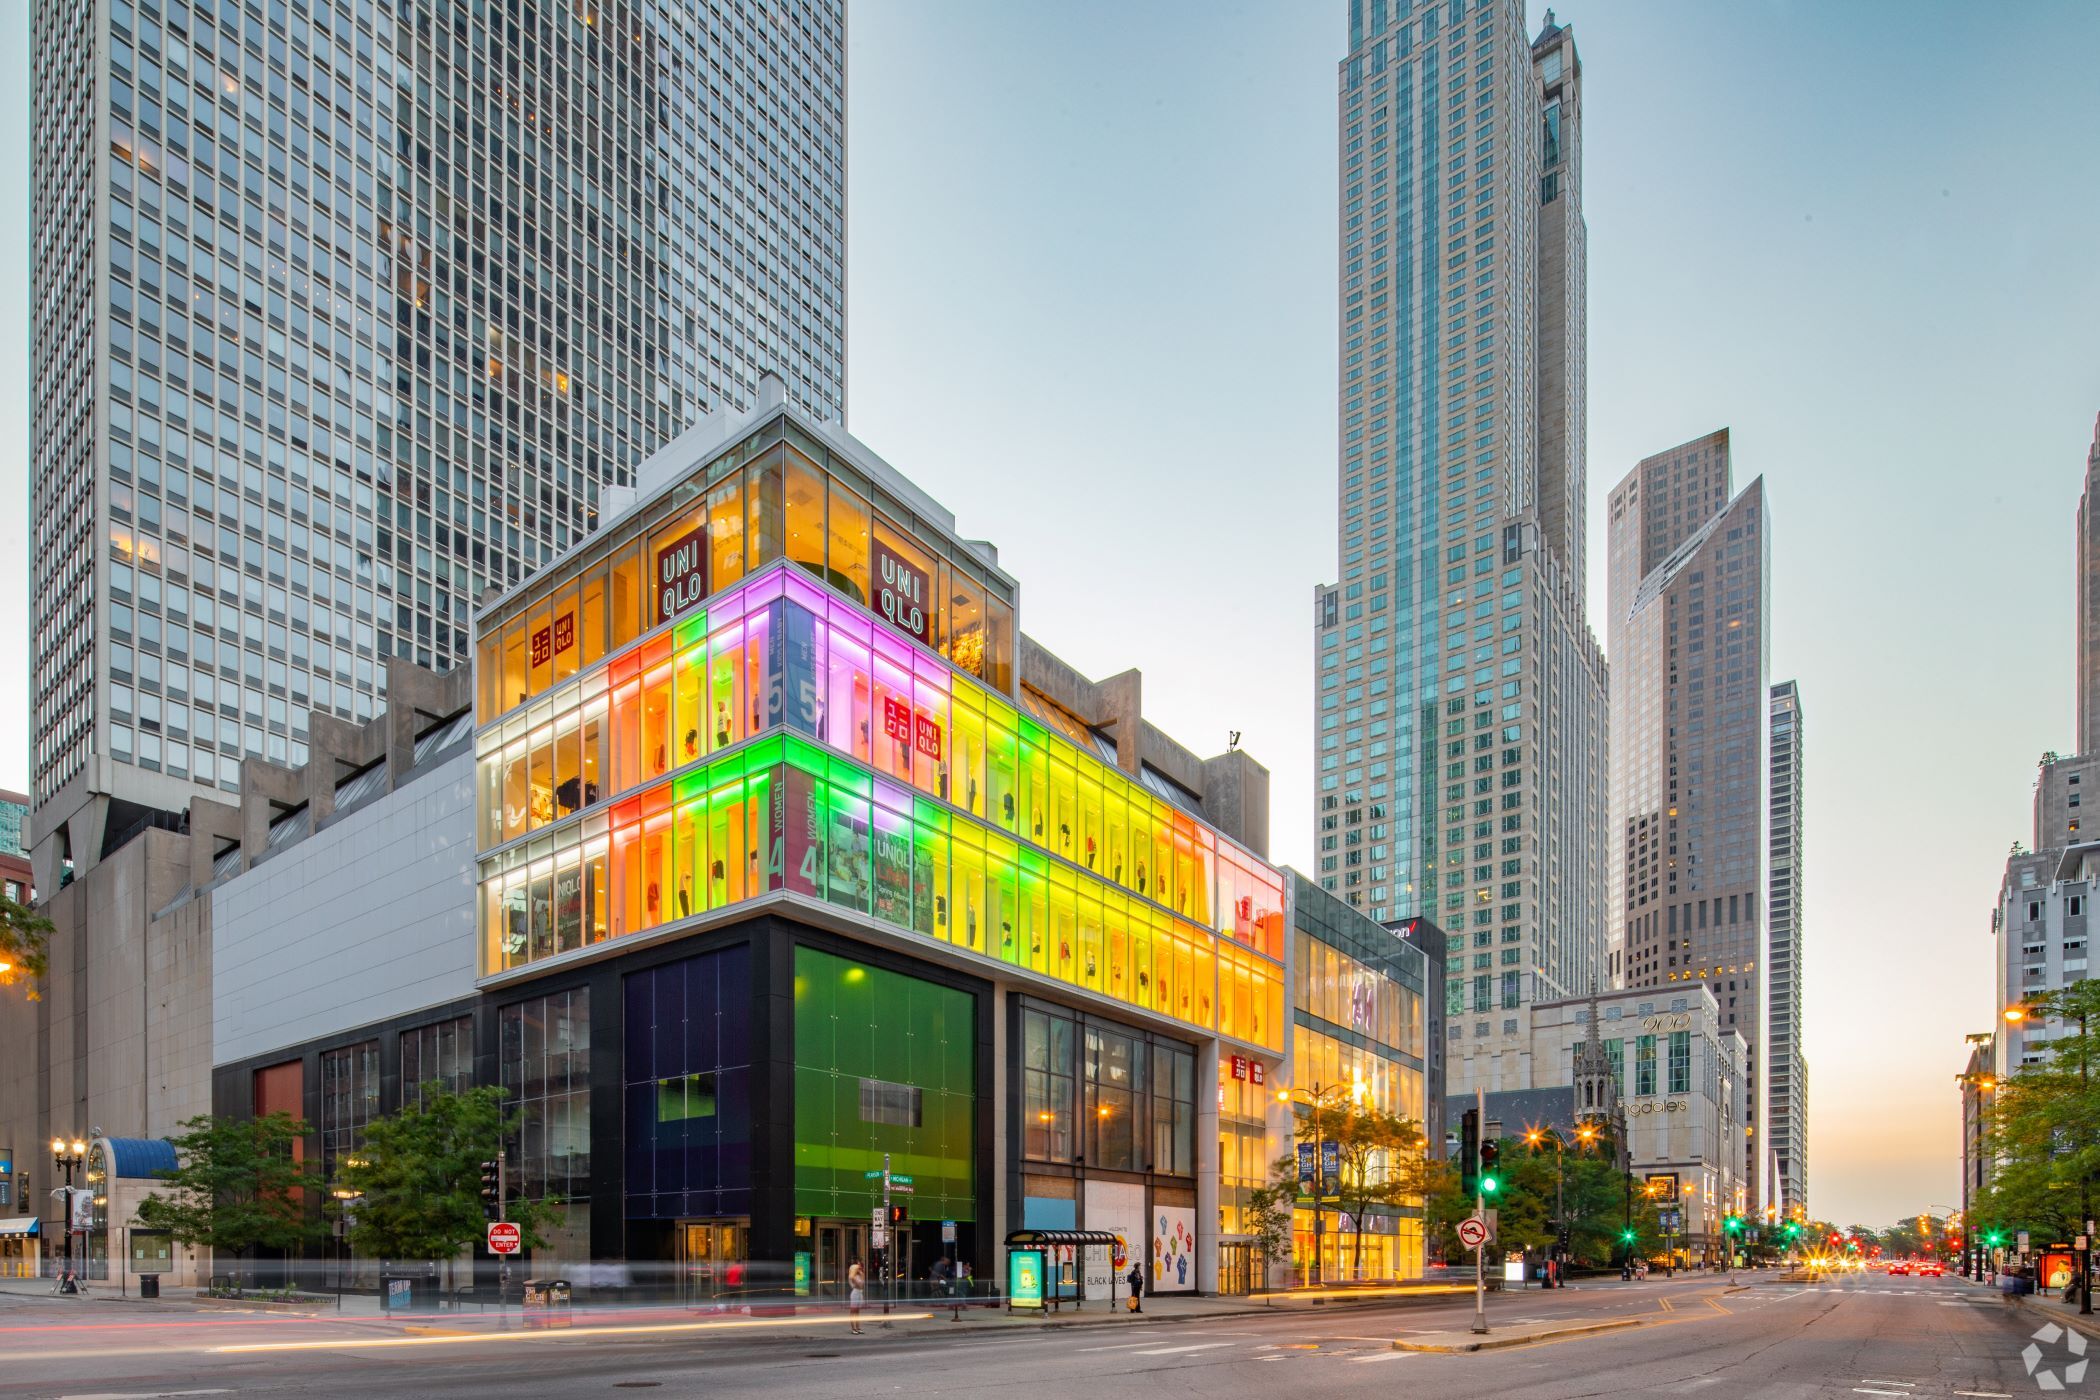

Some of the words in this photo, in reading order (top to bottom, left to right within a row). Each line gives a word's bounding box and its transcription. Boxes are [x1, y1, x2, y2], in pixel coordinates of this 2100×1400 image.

[663, 540, 697, 582] UNI
[882, 553, 919, 603] UNI
[663, 573, 700, 618] QLO
[882, 588, 923, 634] QLO
[556, 618, 570, 636] UNI
[556, 632, 571, 651] QLO
[769, 671, 782, 714] 5
[800, 680, 816, 723] 5
[919, 720, 937, 741] UNI
[919, 735, 939, 755] QLO
[775, 782, 783, 832] WOMEN
[807, 791, 816, 840] WOMEN
[769, 836, 782, 877] 4
[800, 845, 816, 887] 4
[1643, 1013, 1691, 1034] 900
[1618, 1100, 1687, 1118] ngdale's
[1087, 1276, 1107, 1285] BLACK
[1109, 1276, 1126, 1285] LVES
